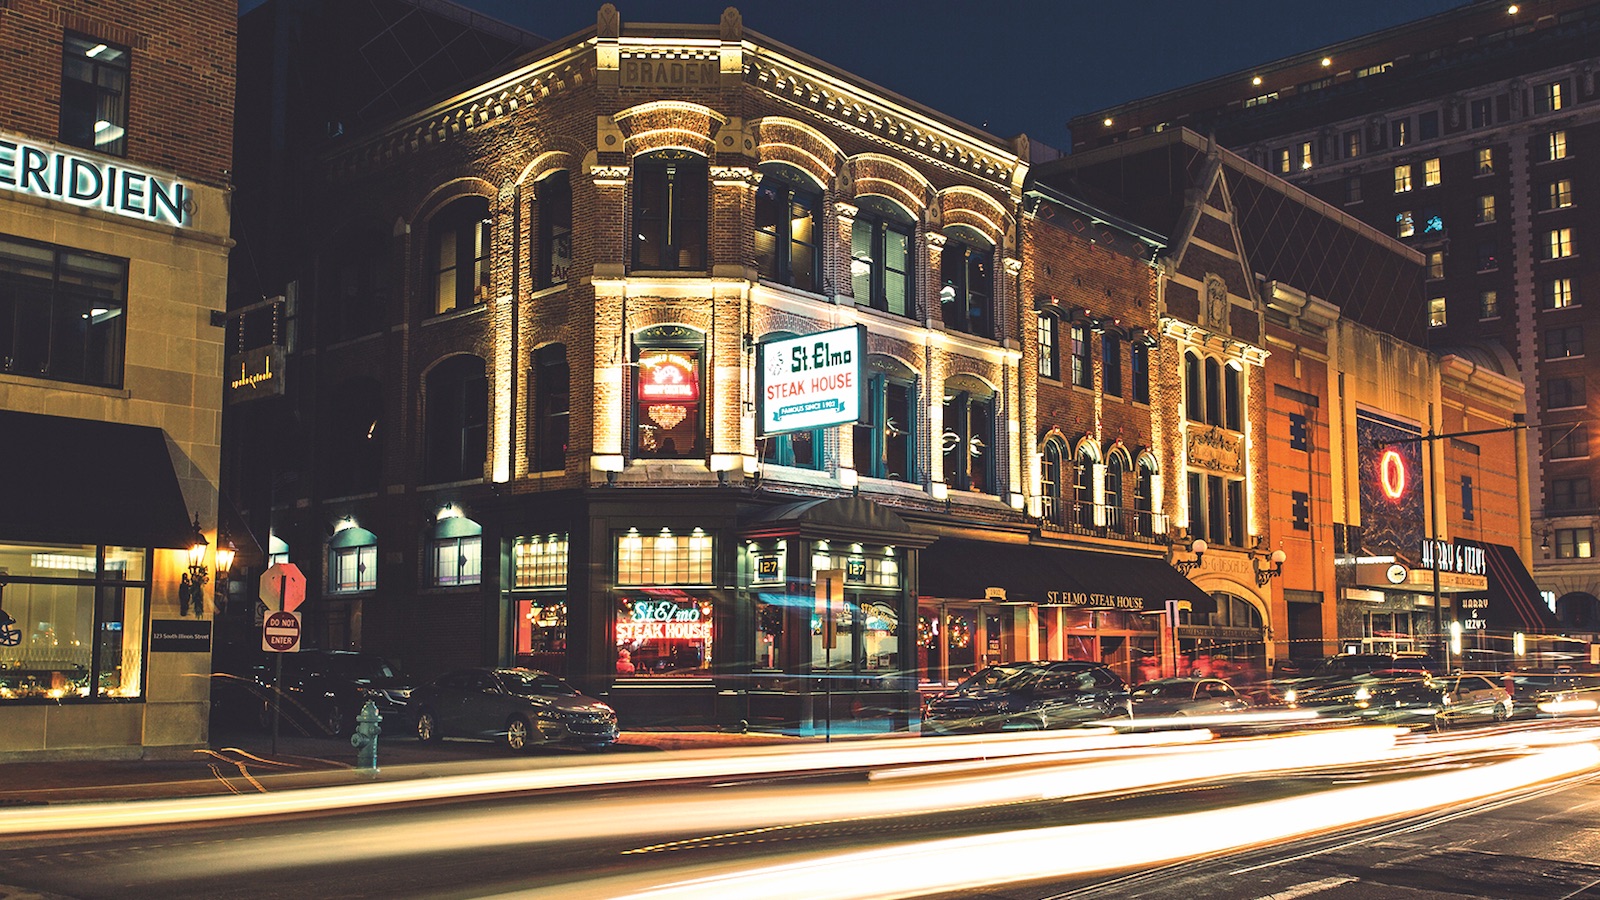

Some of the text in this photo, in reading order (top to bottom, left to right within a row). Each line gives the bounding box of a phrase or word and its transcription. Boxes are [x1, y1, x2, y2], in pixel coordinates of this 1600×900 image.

[767, 372, 852, 400] STEAK HOUSE
[781, 405, 804, 414] FAMOUS
[804, 403, 821, 411] SINCE
[759, 560, 778, 574] 127
[848, 563, 866, 575] 127
[1047, 591, 1145, 609] ST. ELMO STEAK HOUSE
[1462, 599, 1488, 608] HARRY
[654, 600, 700, 623] Elmo
[1471, 609, 1478, 618] &
[269, 618, 296, 627] DO NOT
[1465, 619, 1487, 629] IZZY'S
[616, 622, 711, 640] STEAK HOUSE
[270, 636, 293, 645] ENTER
